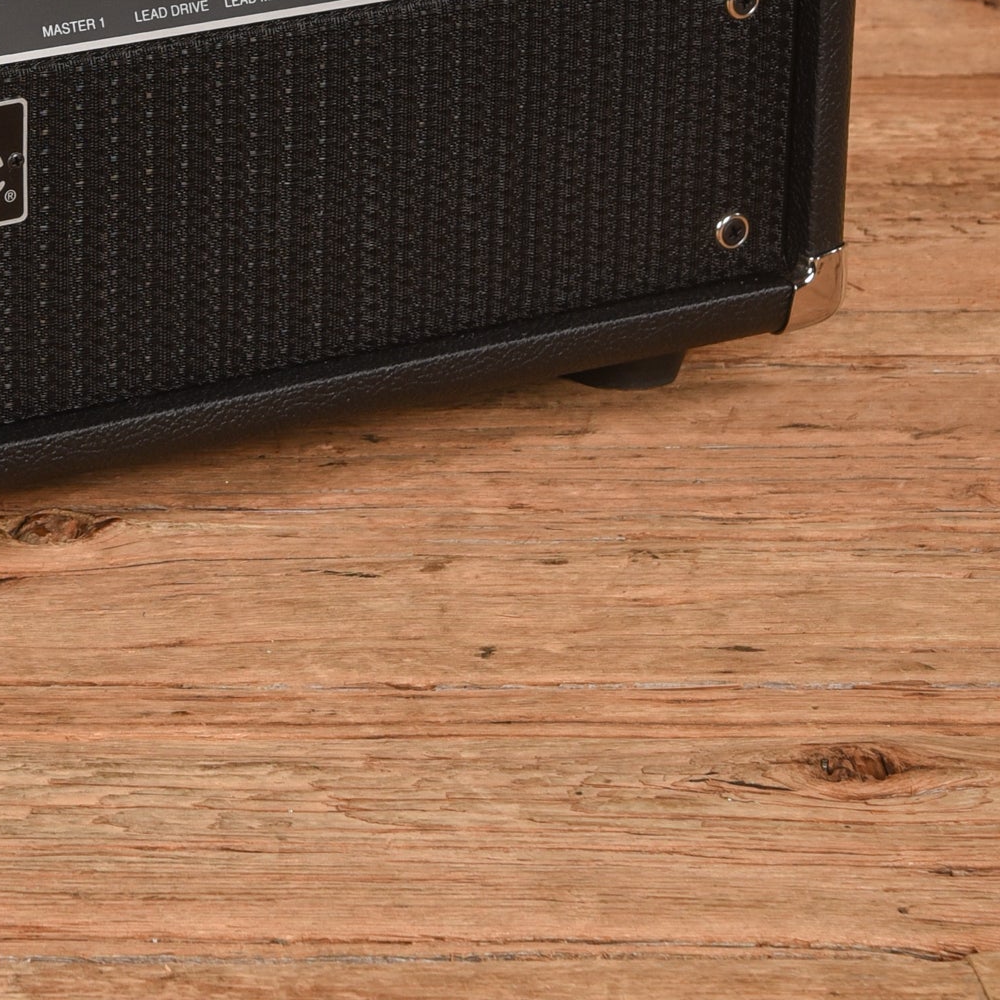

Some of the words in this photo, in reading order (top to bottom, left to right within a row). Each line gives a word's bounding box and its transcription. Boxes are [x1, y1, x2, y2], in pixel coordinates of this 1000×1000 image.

[134, 6, 168, 23] LEAD
[171, 0, 209, 17] DRIVE
[43, 19, 96, 38] MASTER
[99, 17, 105, 28] 1
